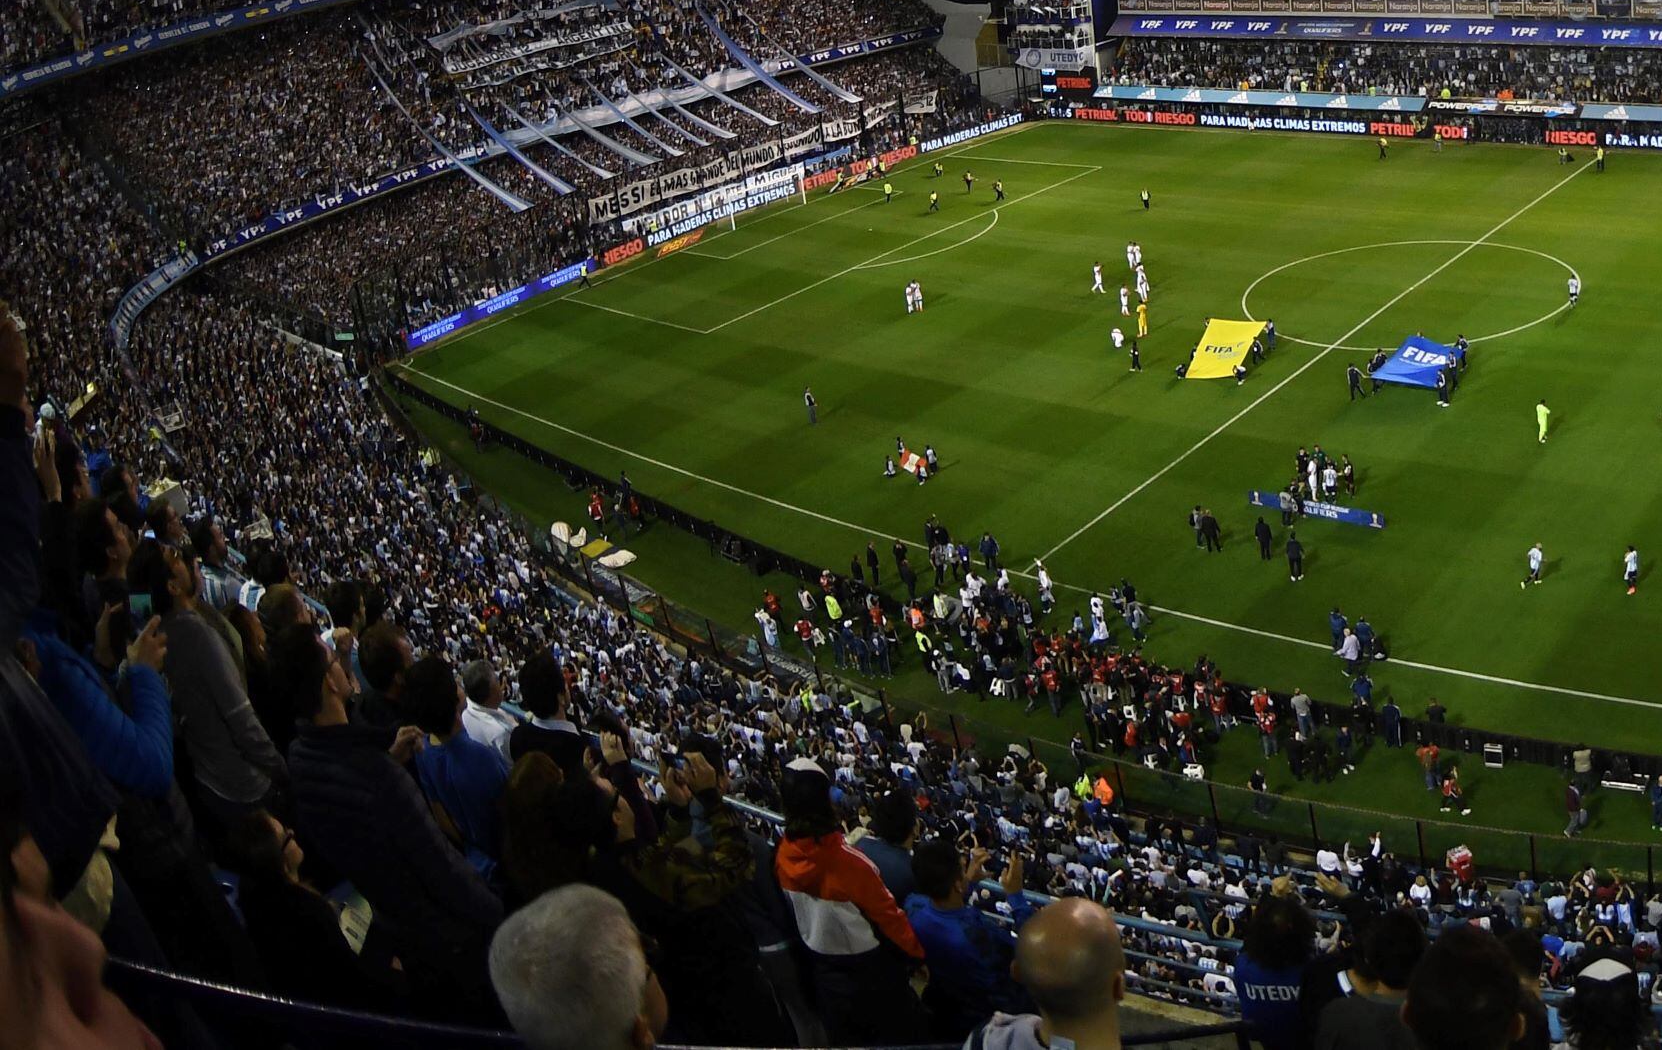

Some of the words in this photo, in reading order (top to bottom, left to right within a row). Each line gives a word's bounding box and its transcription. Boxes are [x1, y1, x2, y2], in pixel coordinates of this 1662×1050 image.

[1203, 1, 1229, 10] Naranja
[1356, 2, 1384, 11] Naranja
[556, 22, 628, 45] ARGENTINA
[1140, 20, 1164, 29] YPF
[1210, 21, 1235, 30] YPF
[1246, 22, 1272, 31] YPF
[1383, 23, 1409, 33] YPF
[1467, 25, 1495, 36] YPF
[1556, 28, 1585, 38] YPF
[809, 52, 830, 63] YPF
[838, 44, 861, 55] YPF
[872, 37, 894, 48] YPF
[1050, 50, 1084, 63] UTEDYC
[1428, 101, 1496, 111] POWERADE
[1504, 104, 1576, 114] POWERADE
[1154, 111, 1196, 125] RIESGO
[1200, 115, 1226, 126] PARA
[1273, 118, 1310, 131] CLIMAS
[1311, 120, 1366, 134] EXTREMOS
[832, 123, 842, 138] LA
[920, 136, 943, 153] PARA
[943, 126, 980, 146] MADERAS
[980, 116, 1008, 136] CLIMAS
[1370, 122, 1416, 137] PETRIL
[1546, 130, 1597, 145] RIESGO
[880, 146, 917, 166] RIESGO
[594, 185, 645, 219] MESSI
[663, 172, 690, 192] MAS
[724, 151, 740, 172] DEL
[741, 146, 775, 168] MUNDO
[240, 223, 267, 240] YPF
[317, 193, 344, 210] YPF
[392, 168, 419, 183] YPF
[647, 228, 672, 247] PARA
[672, 212, 712, 236] MADERAS
[712, 201, 746, 219] CLIMAS
[748, 183, 796, 208] EXTREMOS
[604, 239, 643, 267] RIESGO
[421, 322, 455, 343] QUALIFIERS
[1204, 344, 1234, 354] FIFA
[1402, 346, 1447, 365] FIFA
